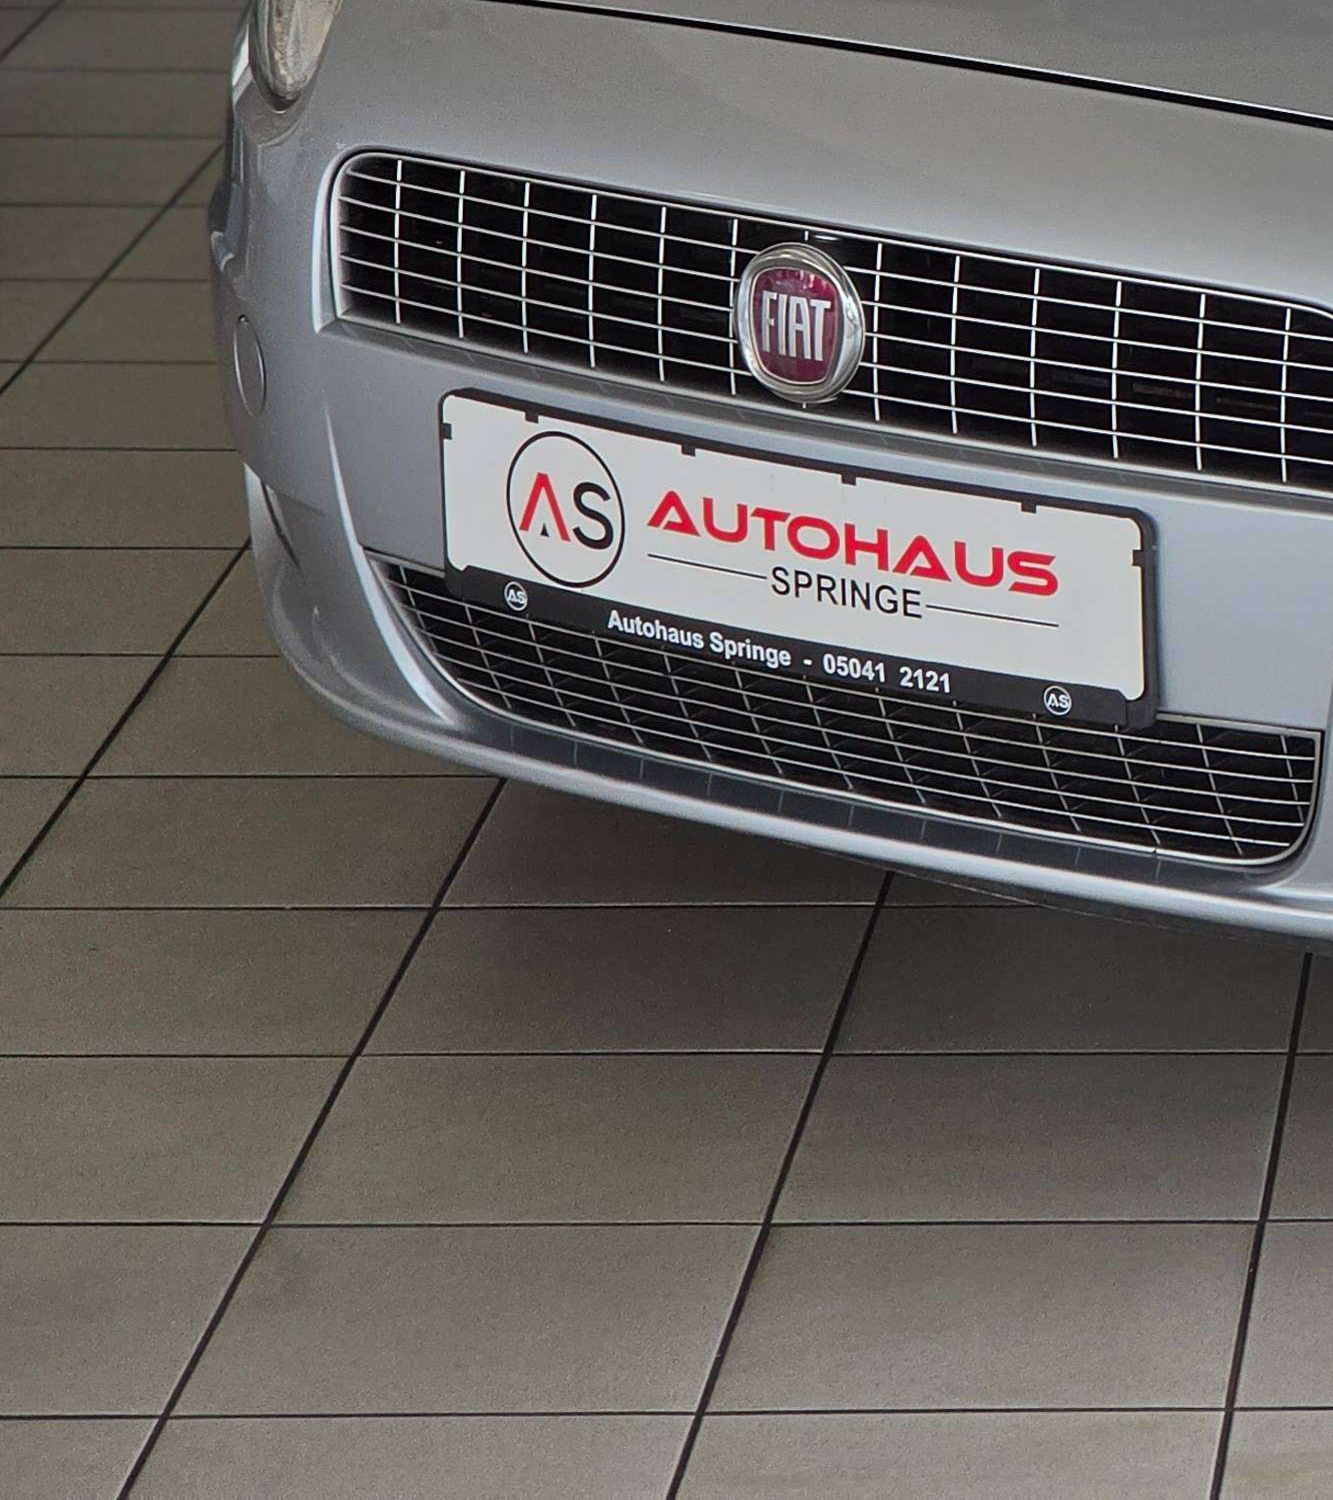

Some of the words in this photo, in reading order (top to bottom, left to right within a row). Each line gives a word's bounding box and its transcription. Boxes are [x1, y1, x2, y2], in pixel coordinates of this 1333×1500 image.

[761, 290, 832, 362] FIAT
[519, 472, 614, 550] AS
[646, 490, 1059, 597] AUTOHAUS
[771, 565, 923, 619] SPRINGE
[608, 609, 705, 649] Autohaus
[709, 632, 792, 668] Springe
[822, 653, 886, 683] 05041
[899, 666, 951, 694] 2121
